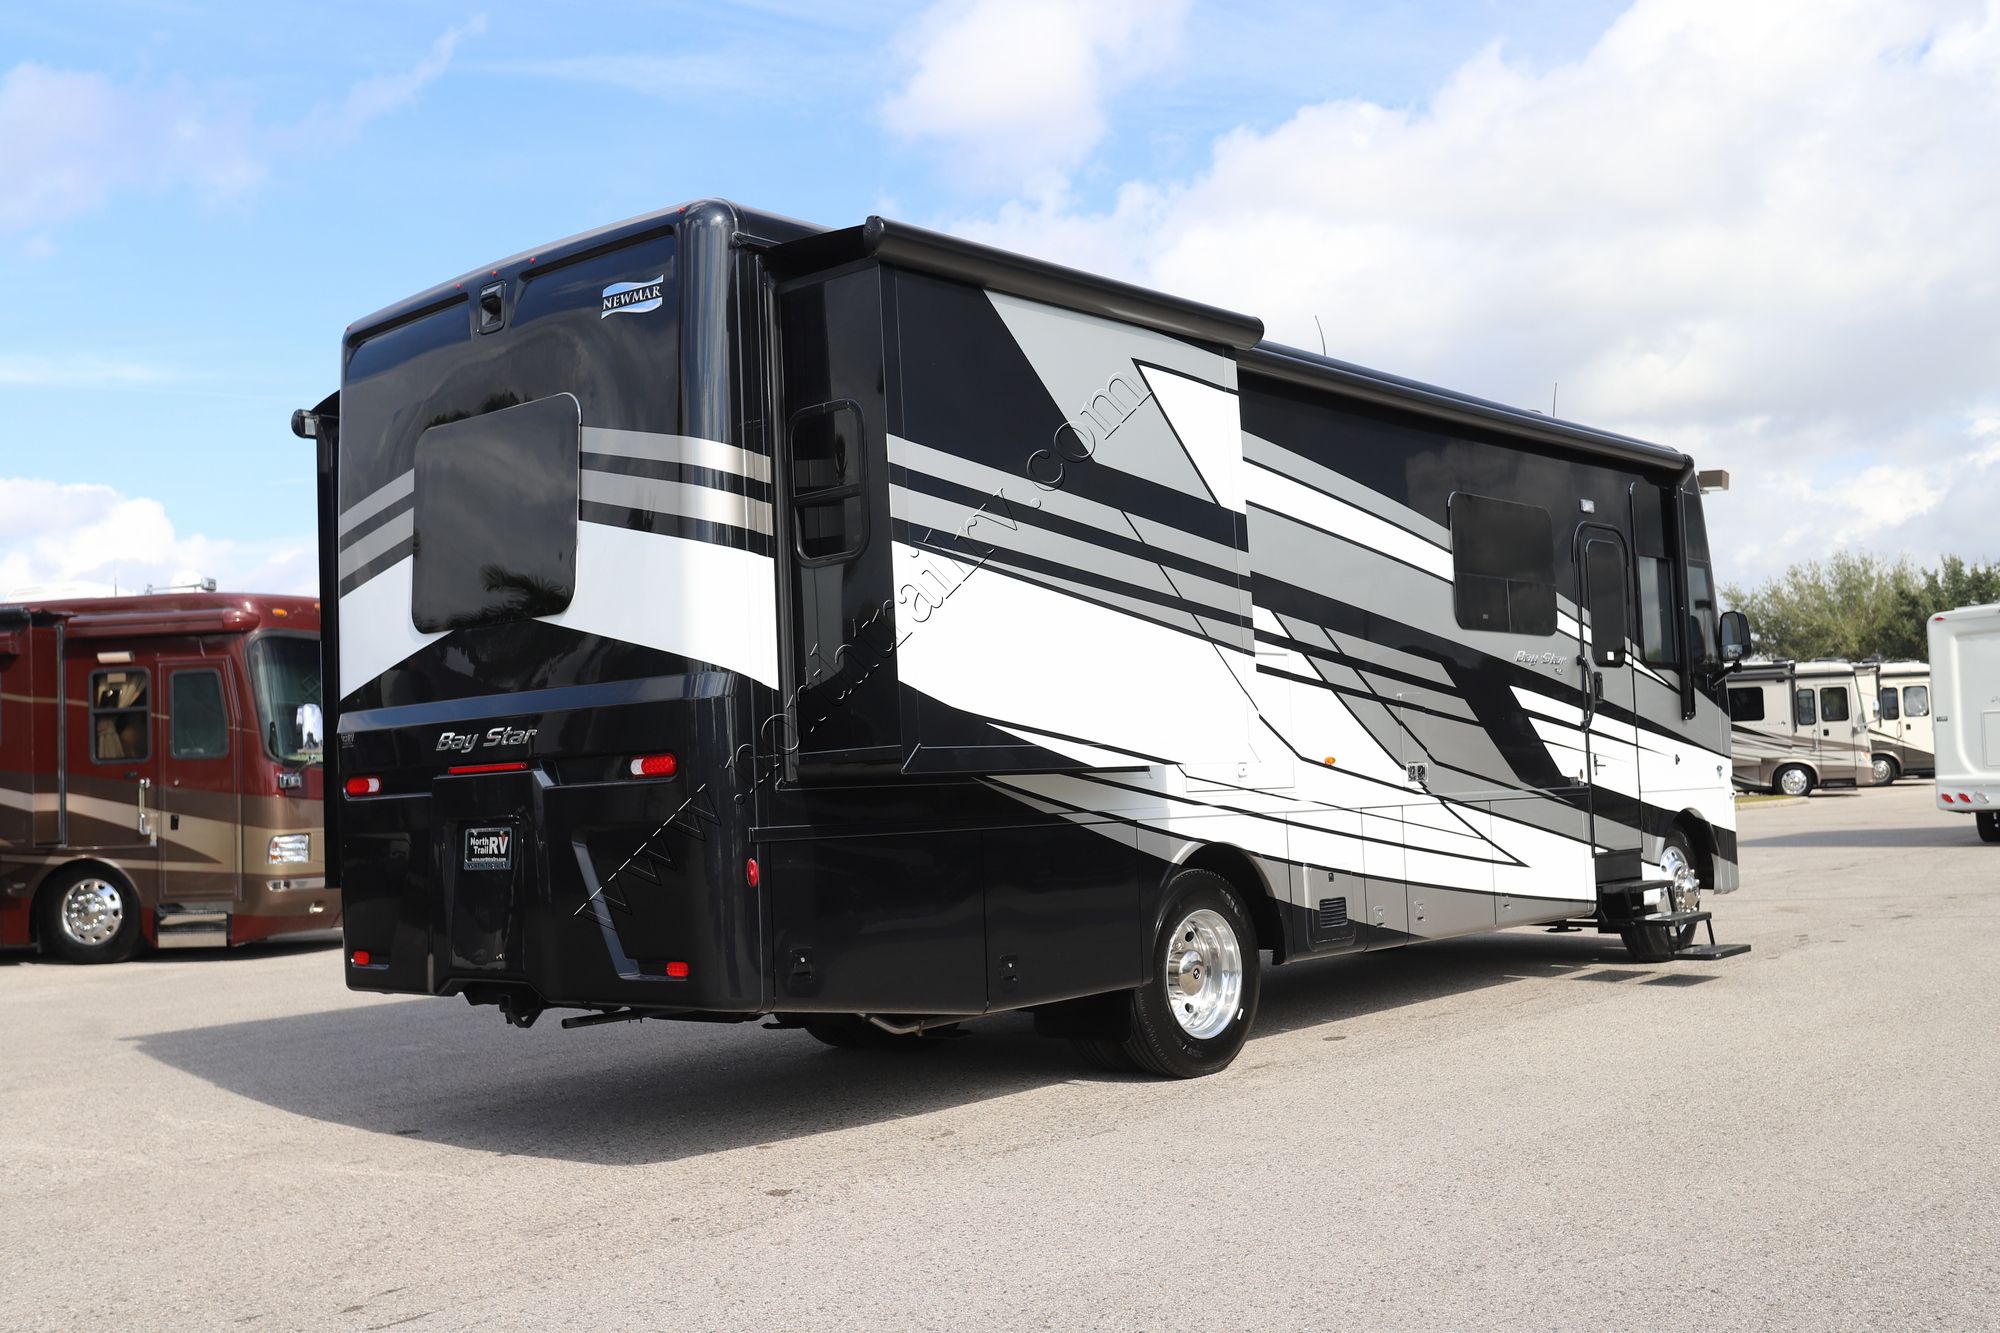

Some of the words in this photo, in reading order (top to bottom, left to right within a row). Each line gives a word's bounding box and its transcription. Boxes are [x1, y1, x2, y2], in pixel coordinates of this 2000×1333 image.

[603, 285, 662, 310] NEWMAR
[436, 732, 479, 753] Bay
[483, 726, 538, 747] Star
[470, 837, 489, 846] North
[473, 846, 489, 854] Trail
[489, 836, 509, 854] RV
